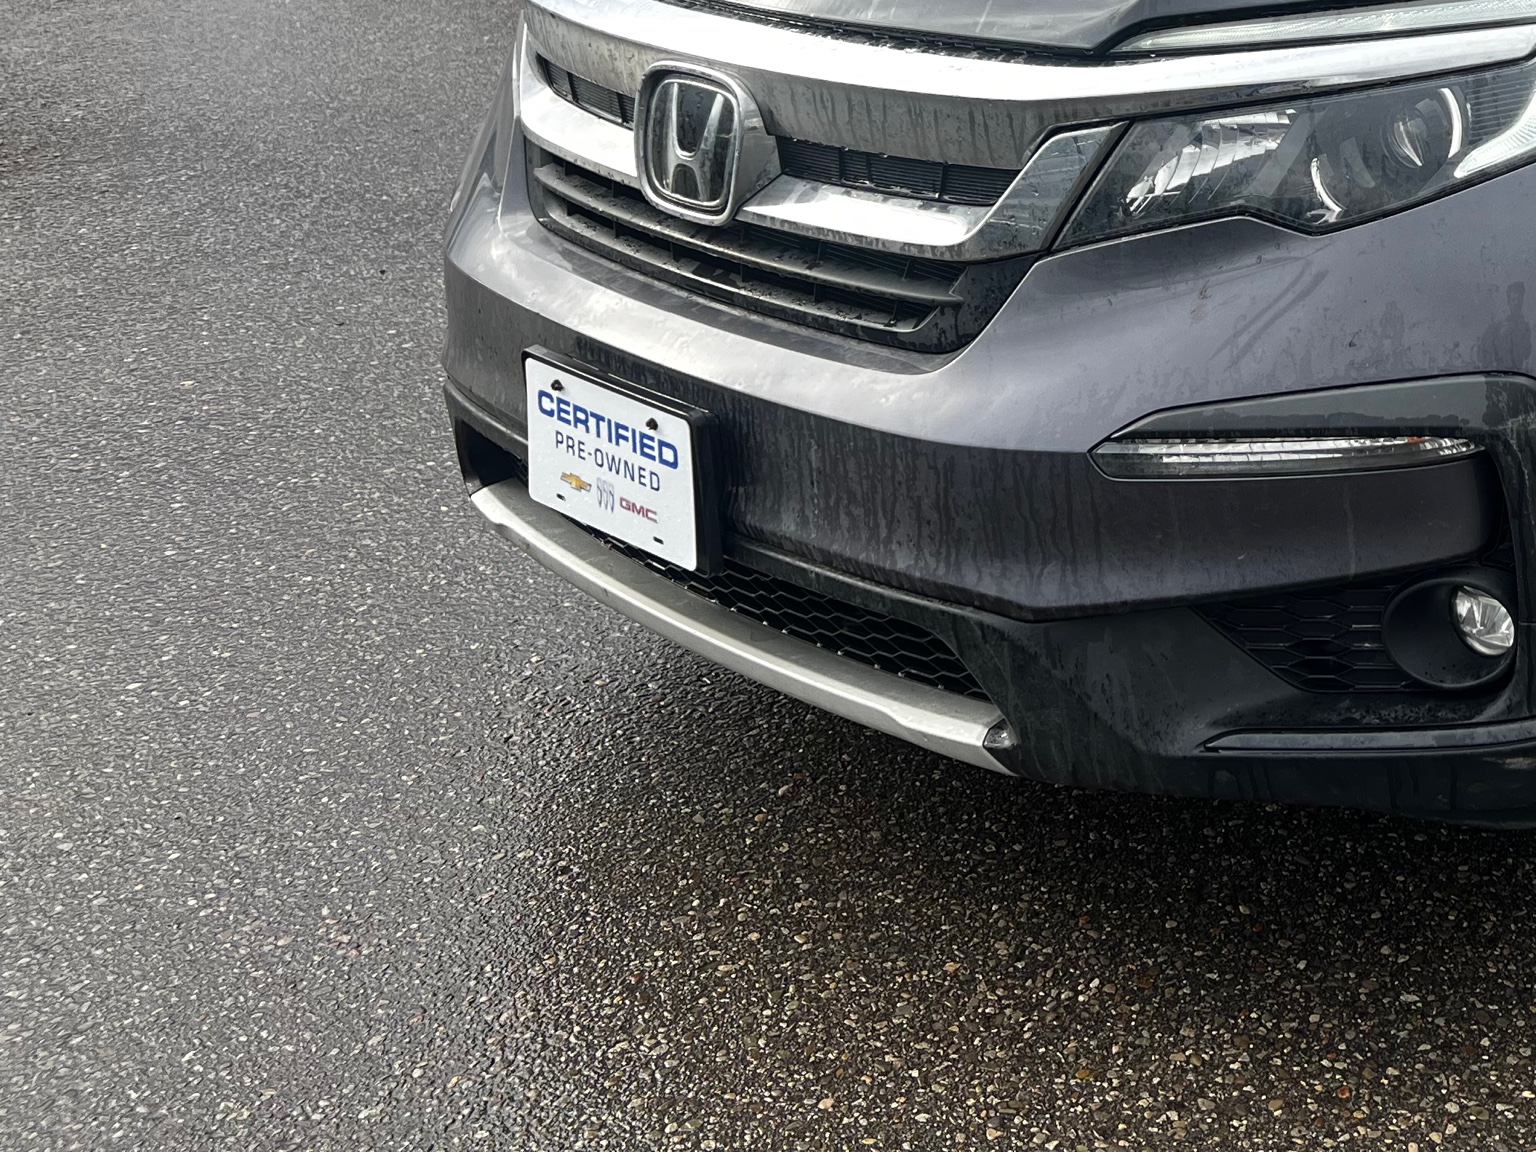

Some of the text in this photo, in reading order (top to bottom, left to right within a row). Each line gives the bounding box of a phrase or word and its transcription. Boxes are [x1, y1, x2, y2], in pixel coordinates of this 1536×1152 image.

[537, 389, 679, 470] CERTIFIED
[555, 430, 661, 492] PRE-OWNED
[619, 497, 659, 524] GMC
